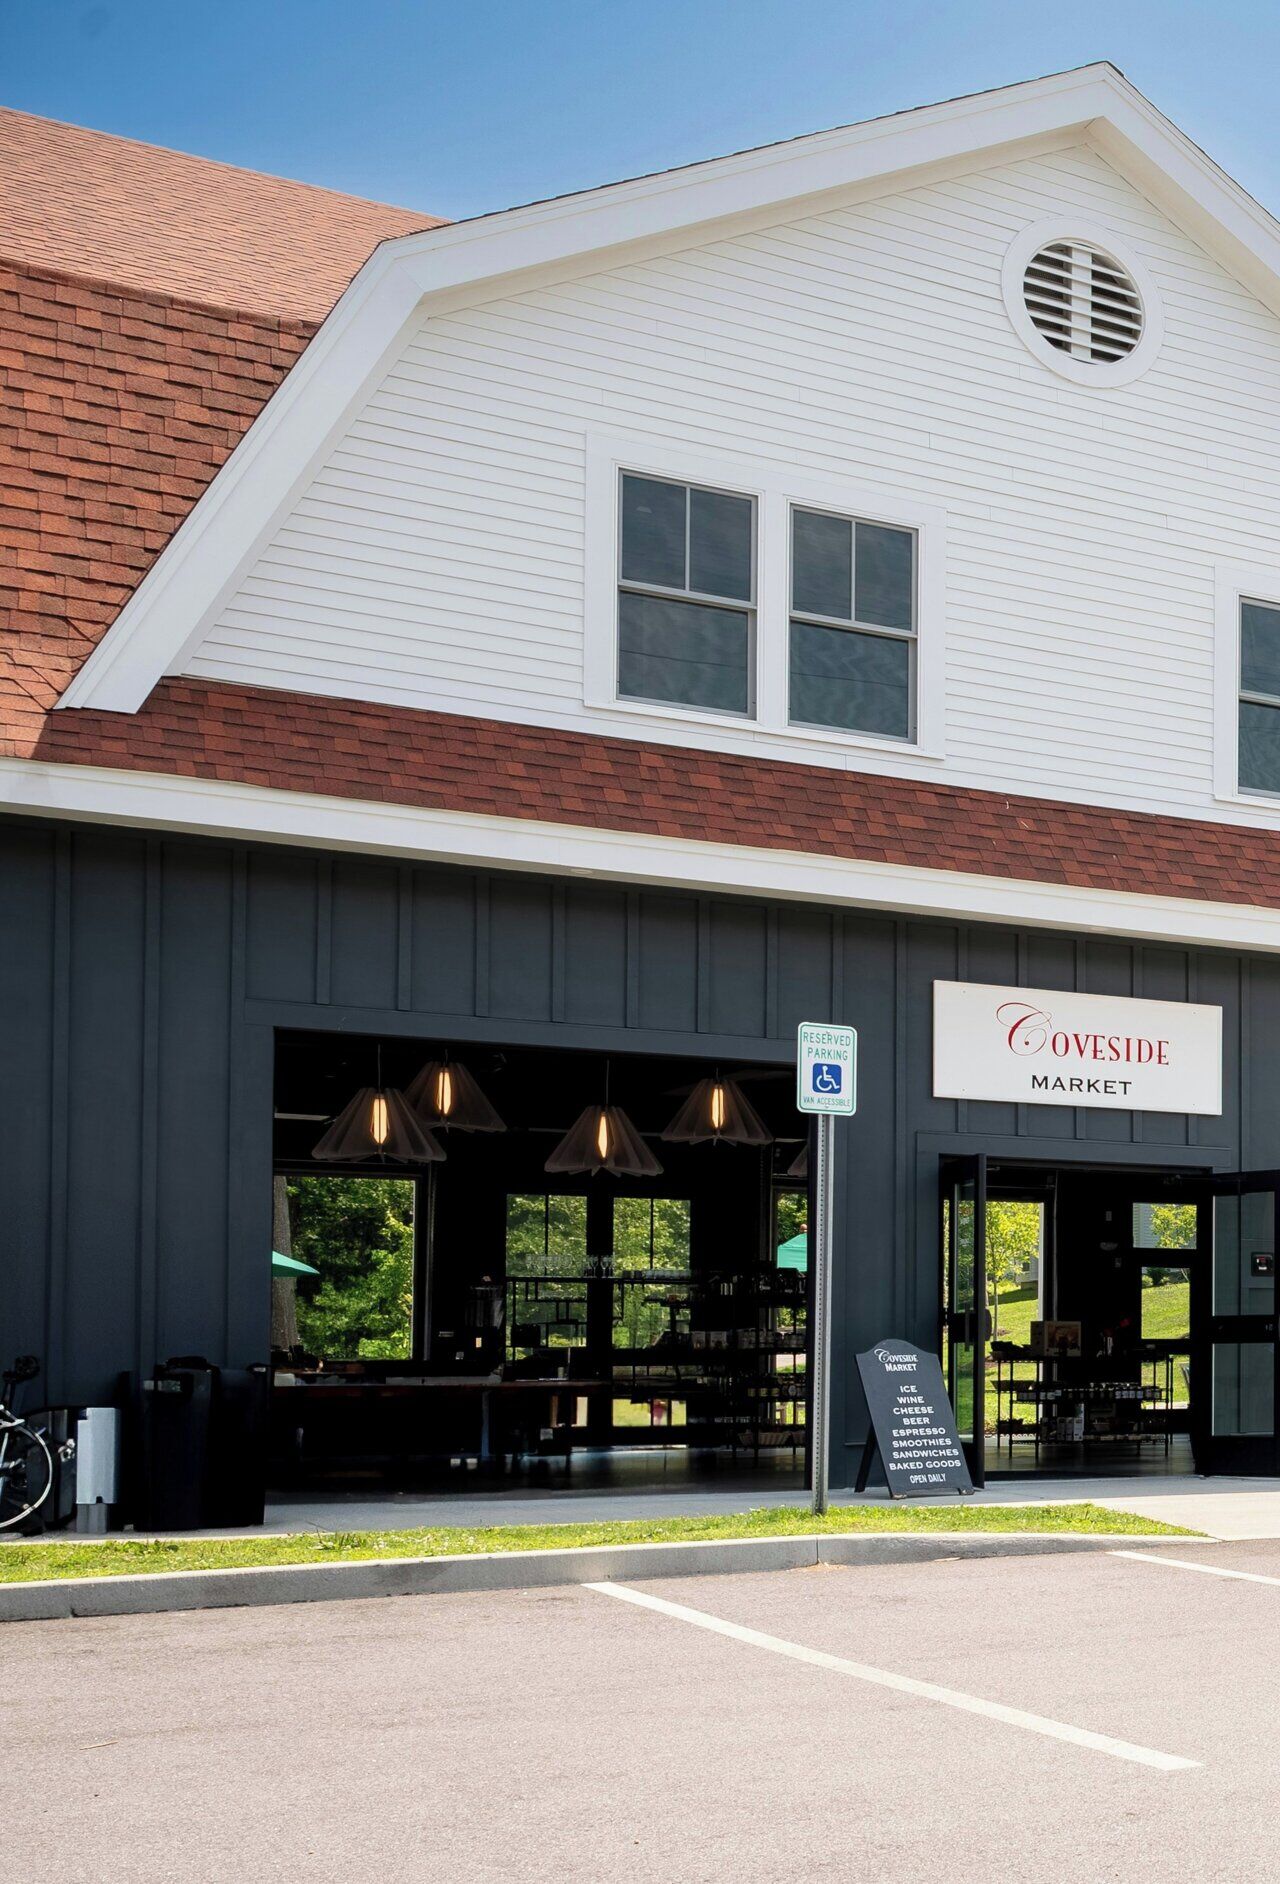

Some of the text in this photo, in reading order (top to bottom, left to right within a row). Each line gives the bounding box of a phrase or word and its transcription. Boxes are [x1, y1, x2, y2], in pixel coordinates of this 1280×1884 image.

[803, 1031, 851, 1047] RESERVED
[996, 1002, 1170, 1066] COVESIDE
[807, 1047, 848, 1061] PARKING
[1031, 1074, 1132, 1095] MARKET
[803, 1095, 851, 1107] VAN ACCESSIBLE
[884, 1363, 917, 1372] MARKET
[900, 1385, 918, 1393] ICE
[897, 1396, 925, 1404] WINE
[893, 1406, 935, 1415] CHEESE
[902, 1417, 930, 1425] BEER
[892, 1427, 946, 1437] ESPRESSO
[892, 1438, 952, 1448] SMOOTHIES
[892, 1449, 959, 1459] SANDWICHES
[889, 1460, 961, 1470] BAKED GOODS
[909, 1473, 946, 1484] OPEN DAILY
